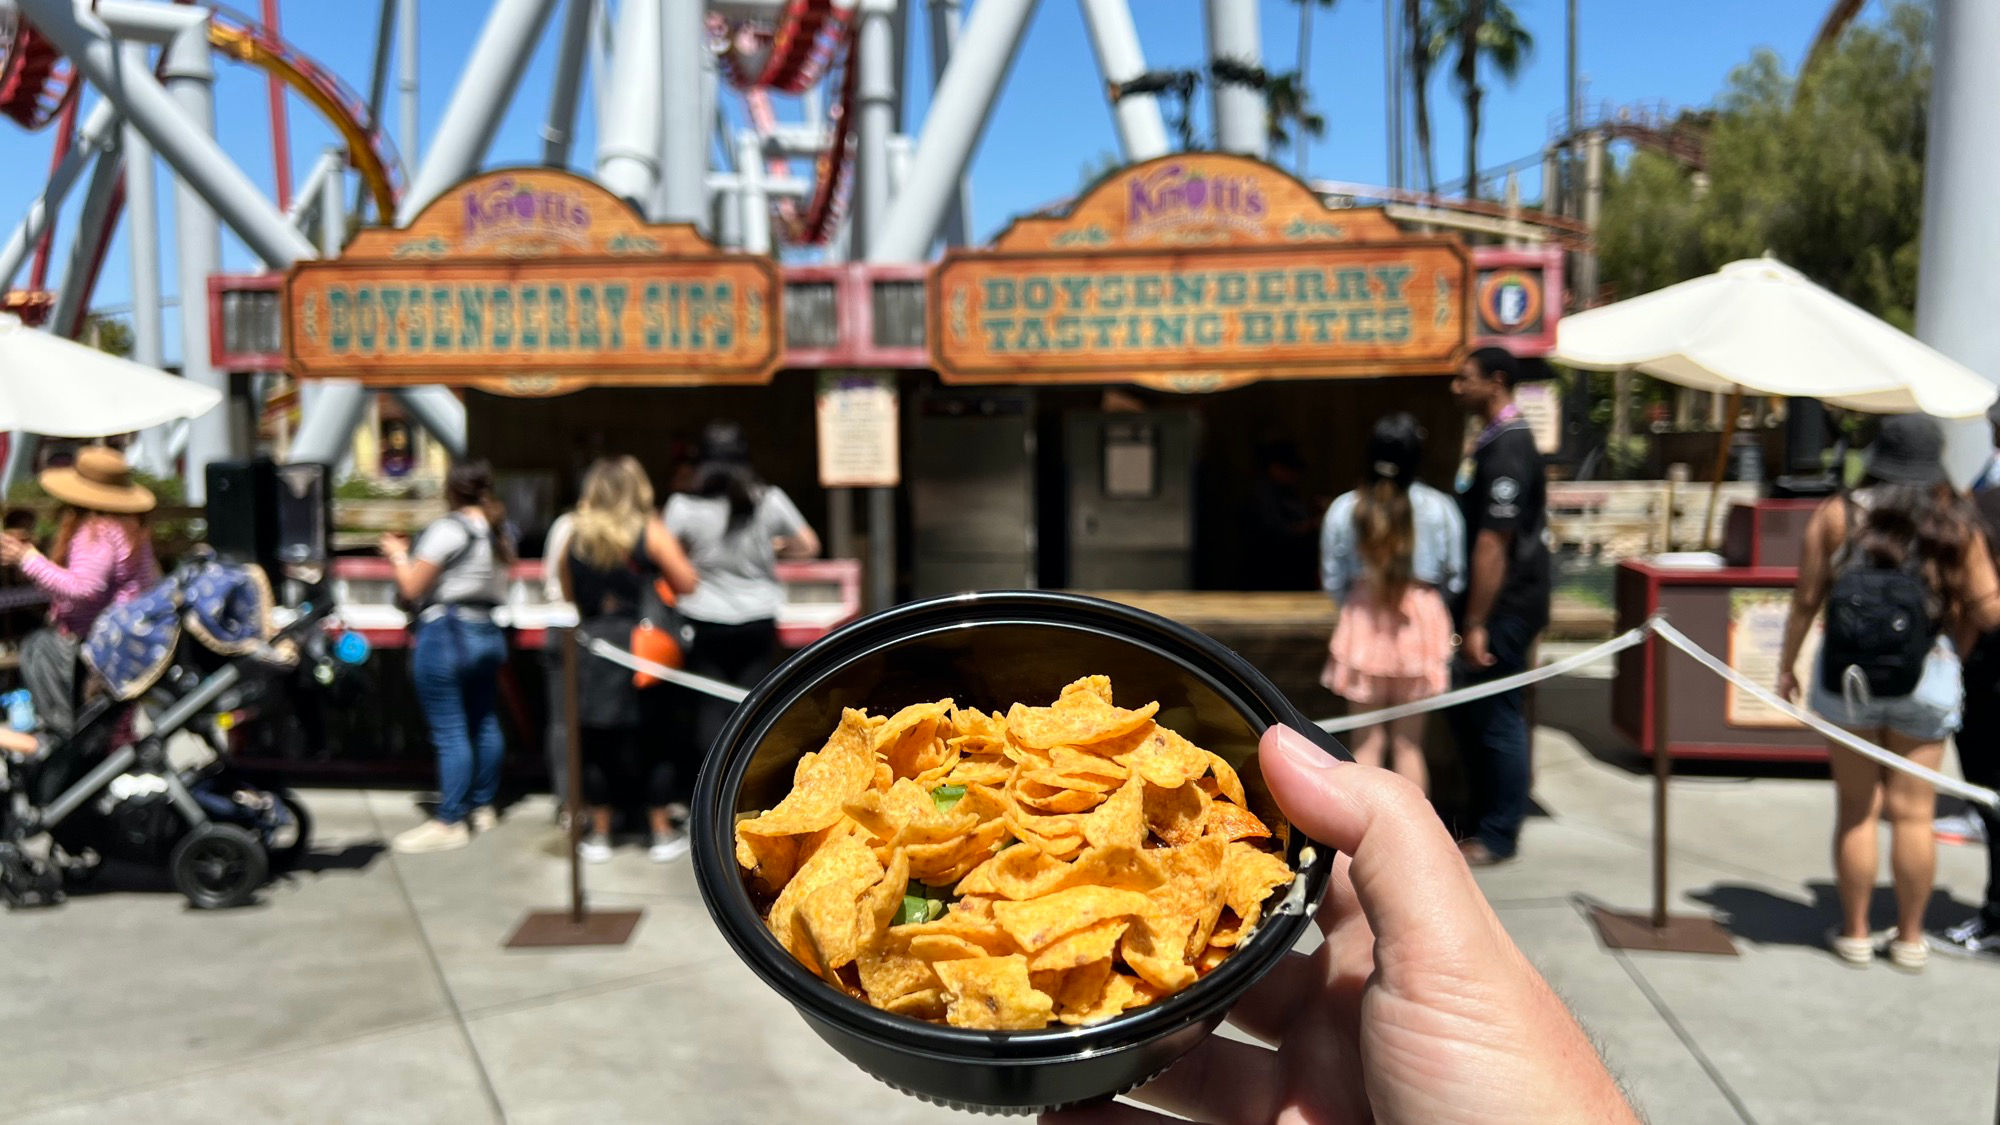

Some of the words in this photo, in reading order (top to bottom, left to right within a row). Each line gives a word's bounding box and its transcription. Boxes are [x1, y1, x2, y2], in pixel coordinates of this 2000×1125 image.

[986, 266, 1411, 312] BOYSENBERRY
[328, 284, 628, 350] BOYSENBERRY
[645, 281, 734, 350] SIPS
[984, 314, 1222, 350] TASTING
[1242, 308, 1410, 347] BITES
